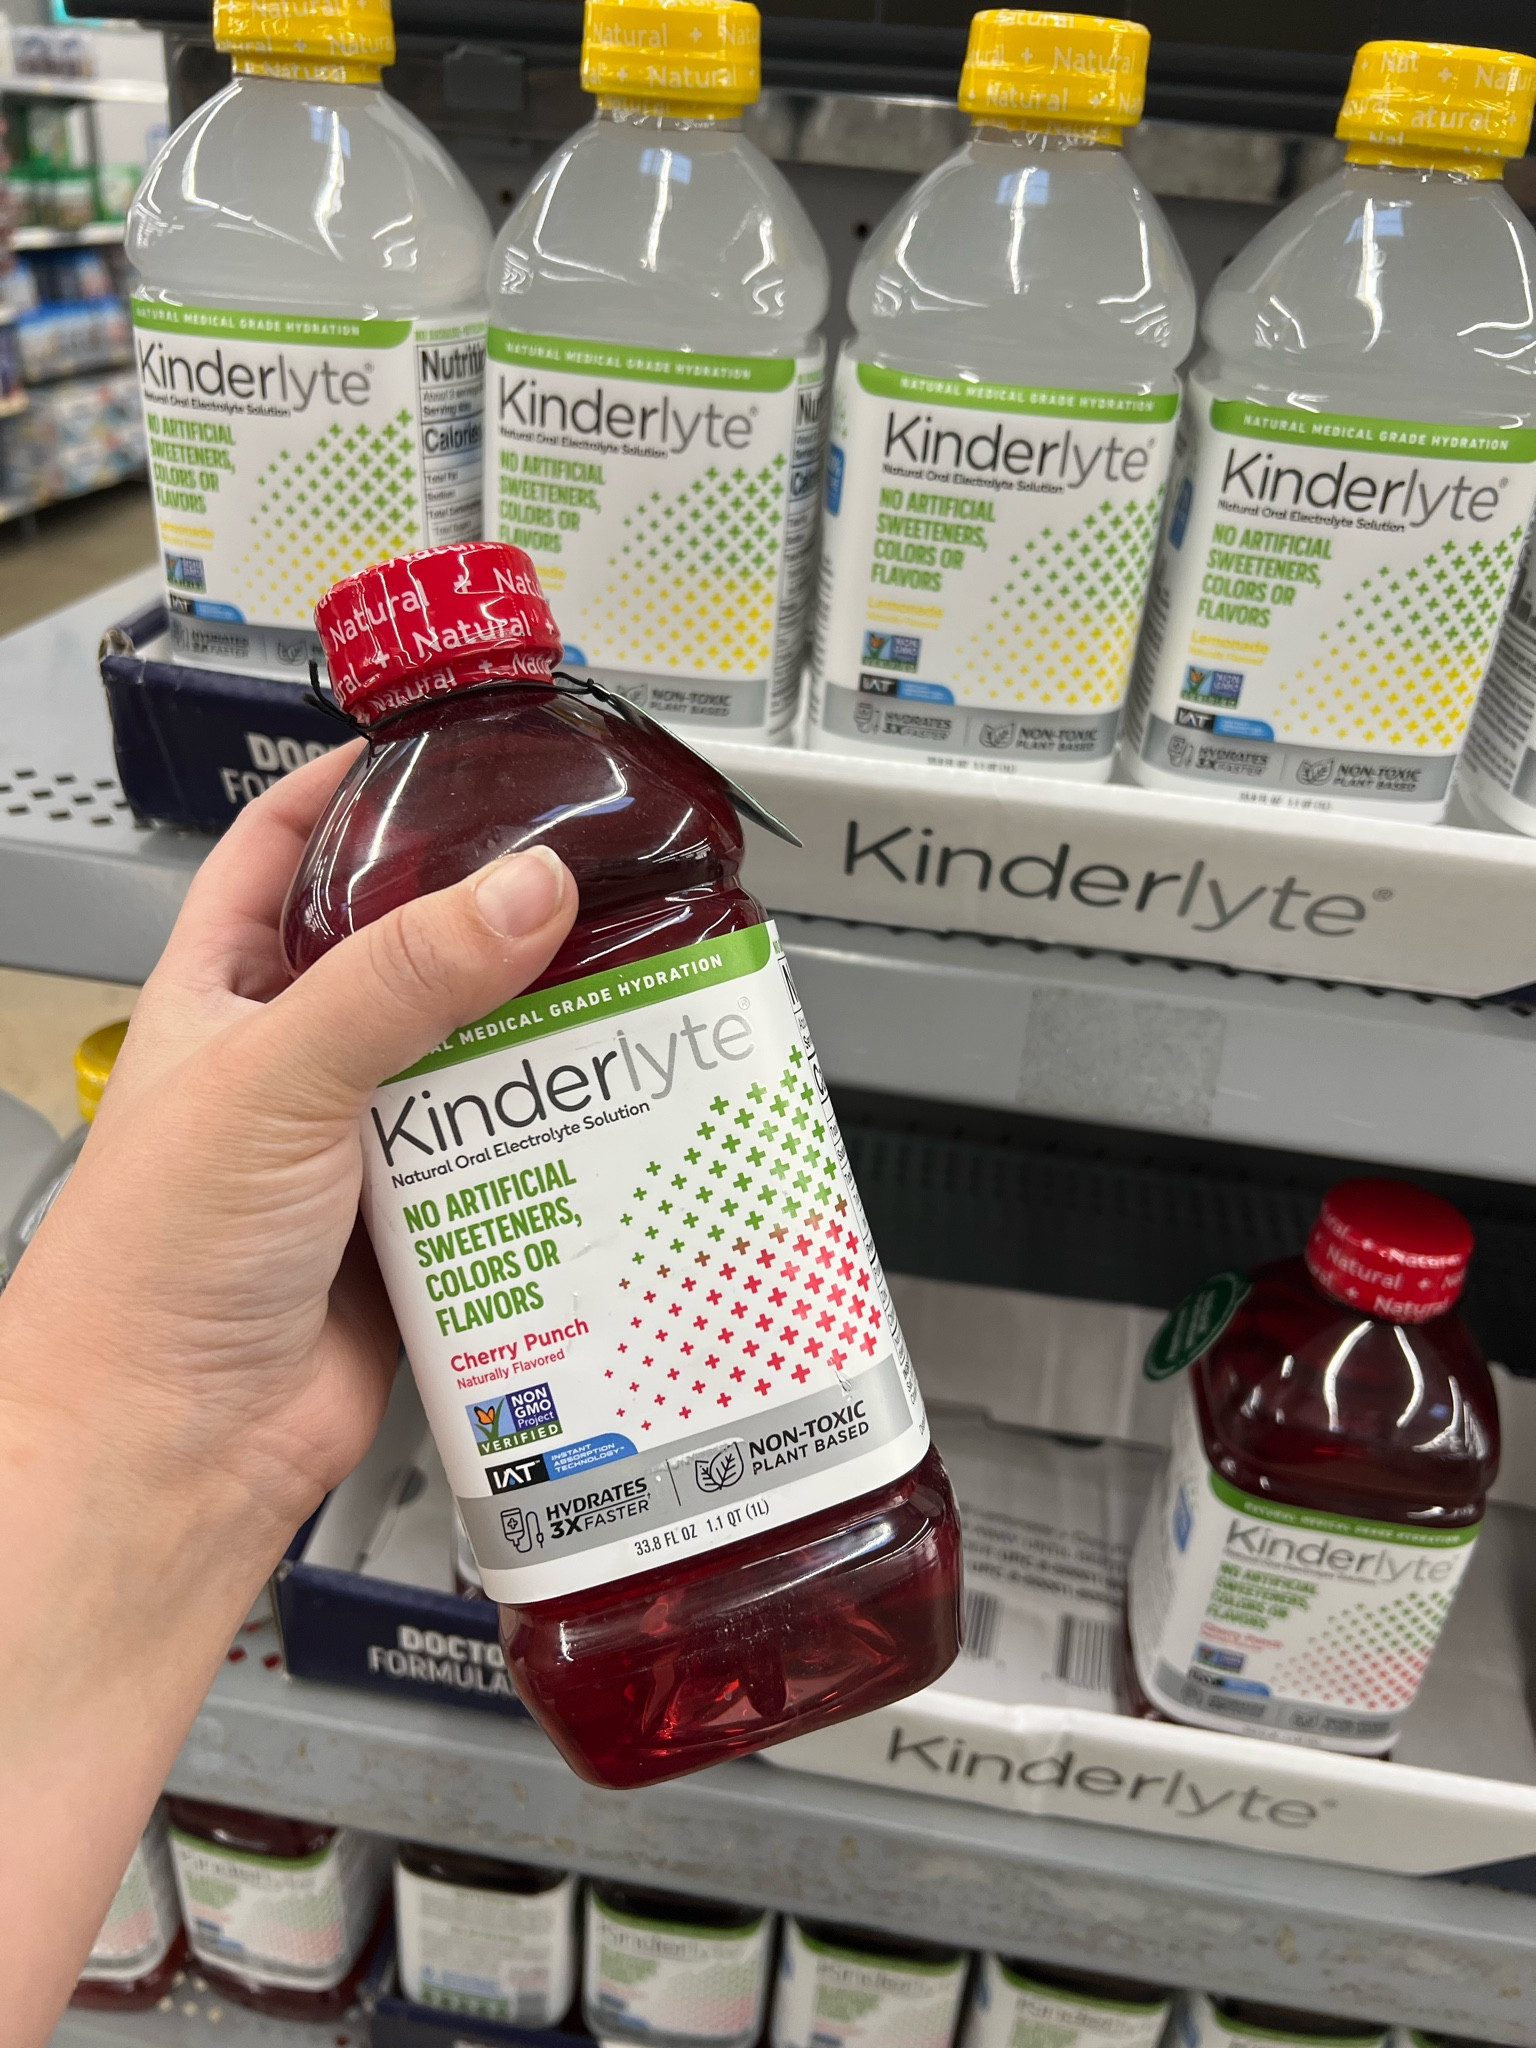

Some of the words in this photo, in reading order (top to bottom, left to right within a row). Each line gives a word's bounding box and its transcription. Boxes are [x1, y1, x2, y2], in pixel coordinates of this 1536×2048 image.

[592, 22, 668, 47] Natural
[649, 64, 737, 89] Natural
[1055, 47, 1136, 74] Natural
[986, 82, 1068, 111] Natural
[184, 312, 234, 330] MEDICAL
[239, 317, 281, 333] GRADE
[285, 320, 360, 337] HYDRATION
[505, 342, 560, 361] NATURAL
[566, 350, 621, 368] MEDICAL
[627, 358, 670, 374] GRADE
[675, 363, 751, 380] HYDRATION
[901, 377, 961, 397] NATURAL
[966, 386, 1024, 403] MEDICAL
[1030, 393, 1074, 408] GRADE
[1079, 396, 1155, 412] HYDRATION
[162, 414, 236, 446] ARTIFICIAL
[1243, 415, 1306, 434] NATURAL
[1311, 424, 1373, 441] MEDICAL
[1379, 430, 1426, 446] GRADE
[1431, 435, 1509, 451] HYDRATION
[199, 472, 219, 492] OR
[500, 449, 519, 471] NO
[522, 454, 606, 485] ARTIFICIAL
[952, 473, 1013, 492] Electrolyte
[1017, 480, 1064, 495] Solution
[500, 475, 601, 515] SWEETENERS,
[880, 488, 904, 511] NO
[906, 490, 996, 523] ARTIFICIAL
[500, 499, 555, 529] COLORS
[559, 510, 581, 531] OR
[1217, 500, 1259, 517] Natural
[1261, 507, 1287, 521] Oral
[1289, 510, 1353, 529] Electrolyte
[1356, 518, 1405, 533] Solution
[500, 526, 562, 553] FLAVORS
[876, 514, 989, 552] SWEETENERS,
[1211, 523, 1237, 546] NO
[1239, 528, 1332, 560] ARTIFICIAL
[874, 539, 936, 570] COLORS
[940, 549, 965, 570] OR
[1207, 549, 1322, 589] SWEETENERS,
[871, 564, 942, 592] FLAVORS
[1202, 574, 1267, 604] COLORS
[1271, 585, 1297, 606] OR
[329, 578, 431, 652] Natural
[1197, 599, 1271, 629] FLAVORS
[411, 609, 532, 659] Natural
[245, 731, 330, 772] DOC
[1019, 727, 1097, 742] NON-TOXIC
[220, 767, 278, 804] FO
[1338, 763, 1422, 782] NON-TOXIC
[459, 1010, 544, 1046] MEDICAL
[549, 988, 613, 1018] GRADE
[617, 953, 724, 998] HYDRATION
[391, 1159, 454, 1190] Natural
[455, 1147, 493, 1170] Oral
[494, 1121, 581, 1159] Electrolyte
[583, 1100, 651, 1130] Solution
[402, 1199, 441, 1233] NO
[445, 1159, 577, 1222] ARTIFICIAL
[414, 1196, 582, 1268] SWEETENERS,
[425, 1250, 522, 1303] COLORS
[523, 1239, 561, 1272] OR
[1327, 1243, 1404, 1291] Natural
[435, 1281, 545, 1337] FLAVORS
[450, 1341, 518, 1372] Cherry
[523, 1318, 590, 1351] Punch
[457, 1366, 510, 1390] Naturally
[512, 1348, 566, 1374] Flavored
[511, 1386, 548, 1408] NON
[514, 1398, 552, 1419] GMO
[517, 1410, 555, 1429] Project
[749, 1400, 866, 1459] NON-TOXIC
[481, 1424, 560, 1454] VERIFIED
[551, 1443, 592, 1461] INSTANT
[553, 1443, 615, 1467] ABSORPTION
[752, 1443, 809, 1475] PLANT
[814, 1421, 870, 1453] BASED
[546, 1477, 648, 1521] HYDRATES
[634, 1536, 662, 1556] 33.8
[664, 1531, 680, 1547] FL
[681, 1523, 698, 1541] OZ
[706, 1516, 724, 1533] 1.1
[727, 1508, 742, 1527] QT
[745, 1499, 770, 1520] (1L)
